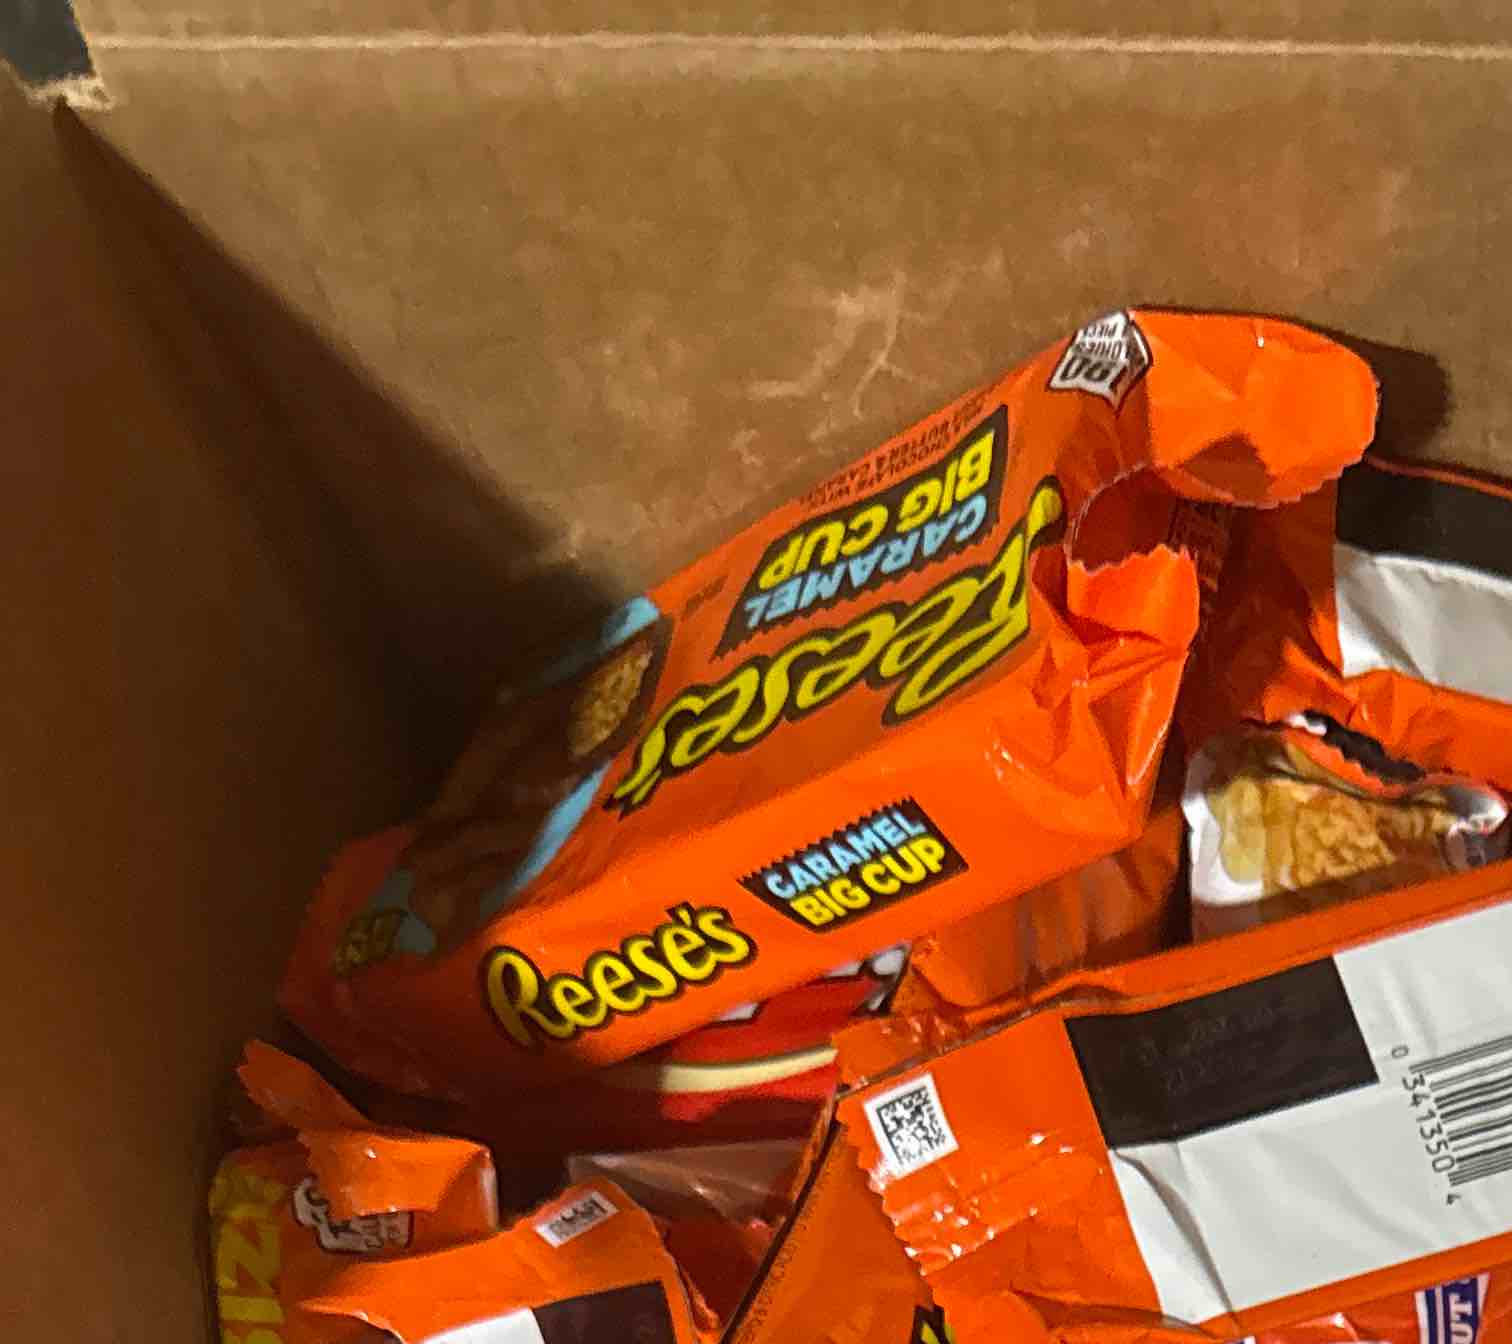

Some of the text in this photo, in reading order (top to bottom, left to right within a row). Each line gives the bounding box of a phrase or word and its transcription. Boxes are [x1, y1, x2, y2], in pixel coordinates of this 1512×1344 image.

[875, 430, 998, 543] BIG
[744, 496, 988, 621] CARAMEL
[761, 508, 888, 586] CUP
[608, 486, 1066, 806] Reese's
[766, 807, 925, 900] CARAMEL
[789, 837, 947, 929] BIG CUP
[490, 906, 750, 1040] Reese's
[1400, 1072, 1456, 1173] 341350
